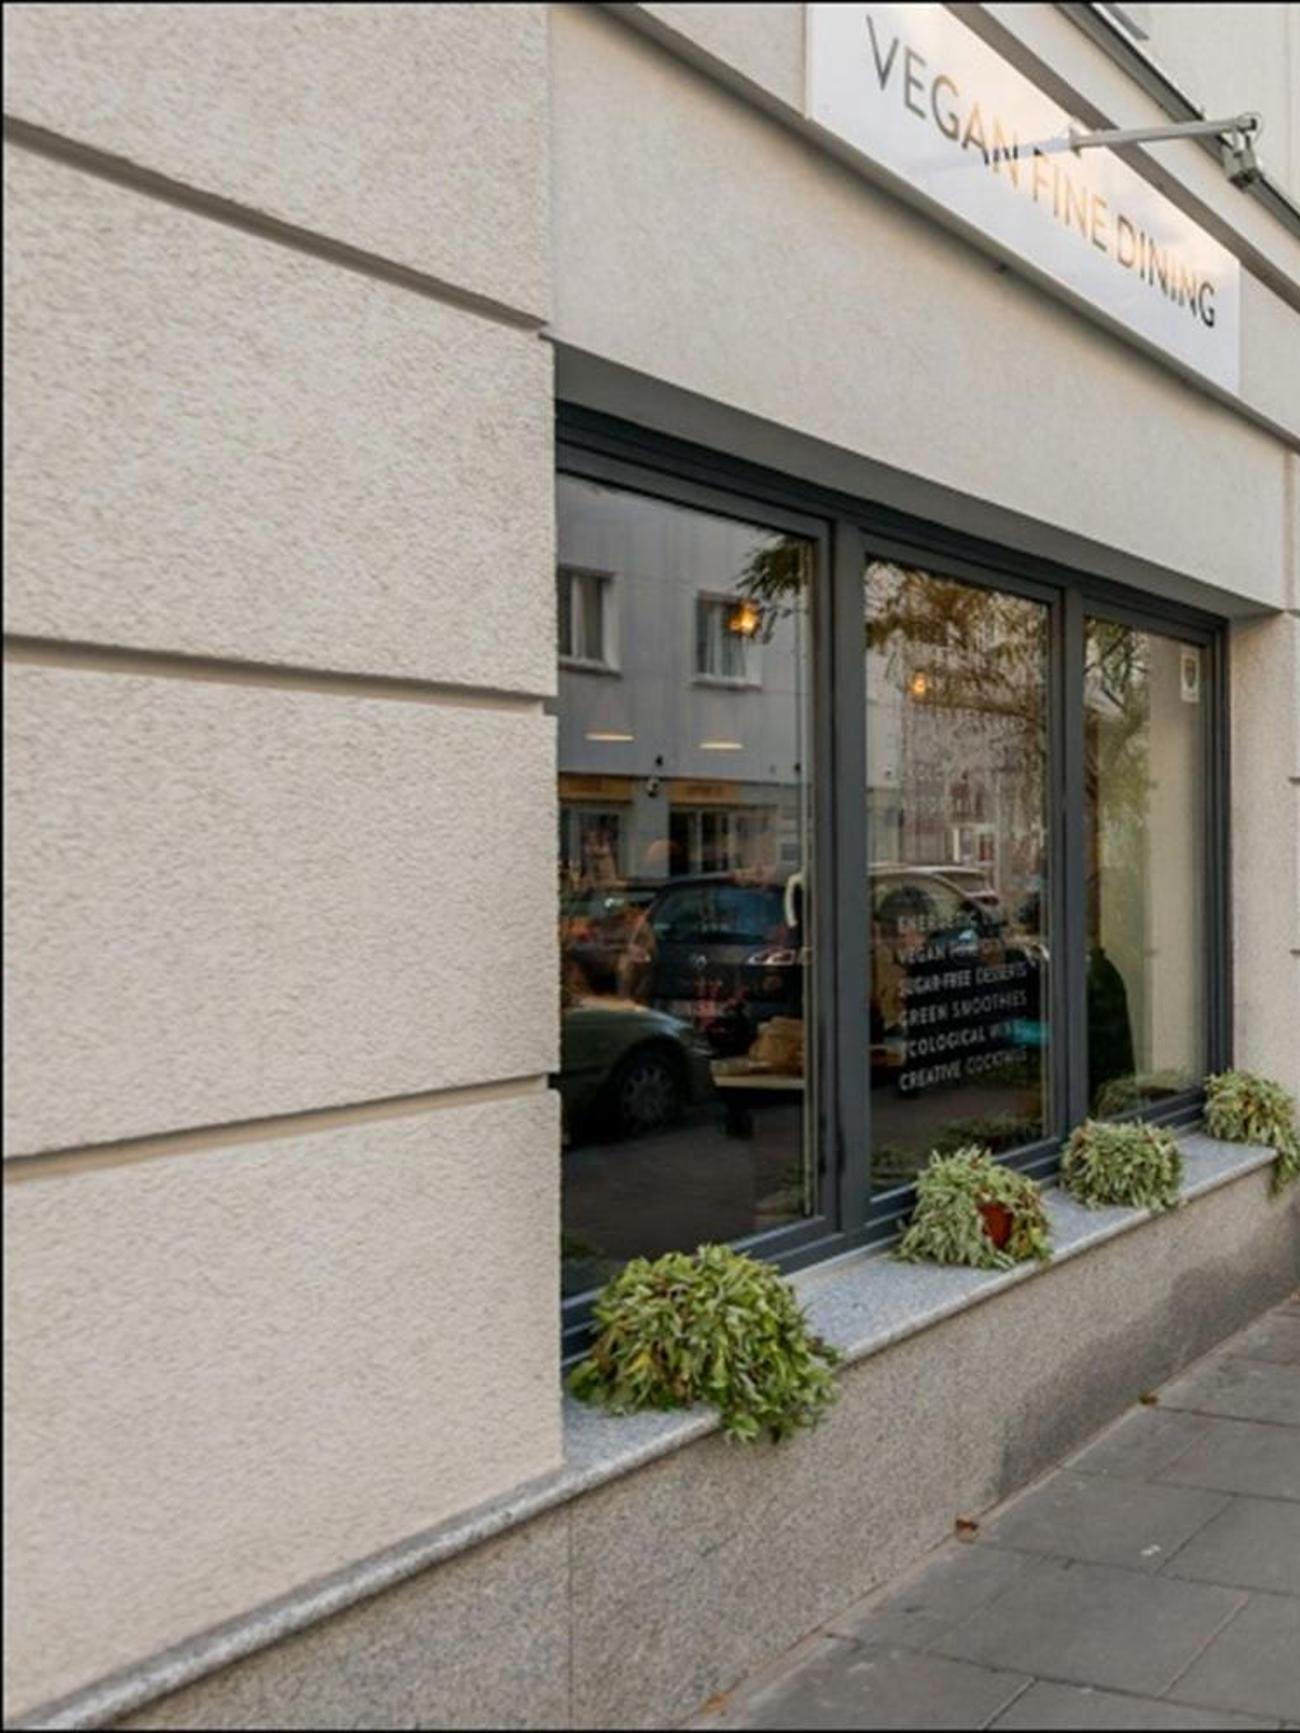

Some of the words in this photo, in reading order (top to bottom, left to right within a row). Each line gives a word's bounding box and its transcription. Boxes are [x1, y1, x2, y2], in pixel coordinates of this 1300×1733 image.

[866, 14, 1020, 189] VEGAN
[1030, 147, 1108, 252] FINE
[1116, 213, 1216, 327] DINING
[897, 1003, 949, 1028] GREEN
[951, 991, 1027, 1017] SMOOTHIES
[899, 1062, 962, 1091] CREATIVE
